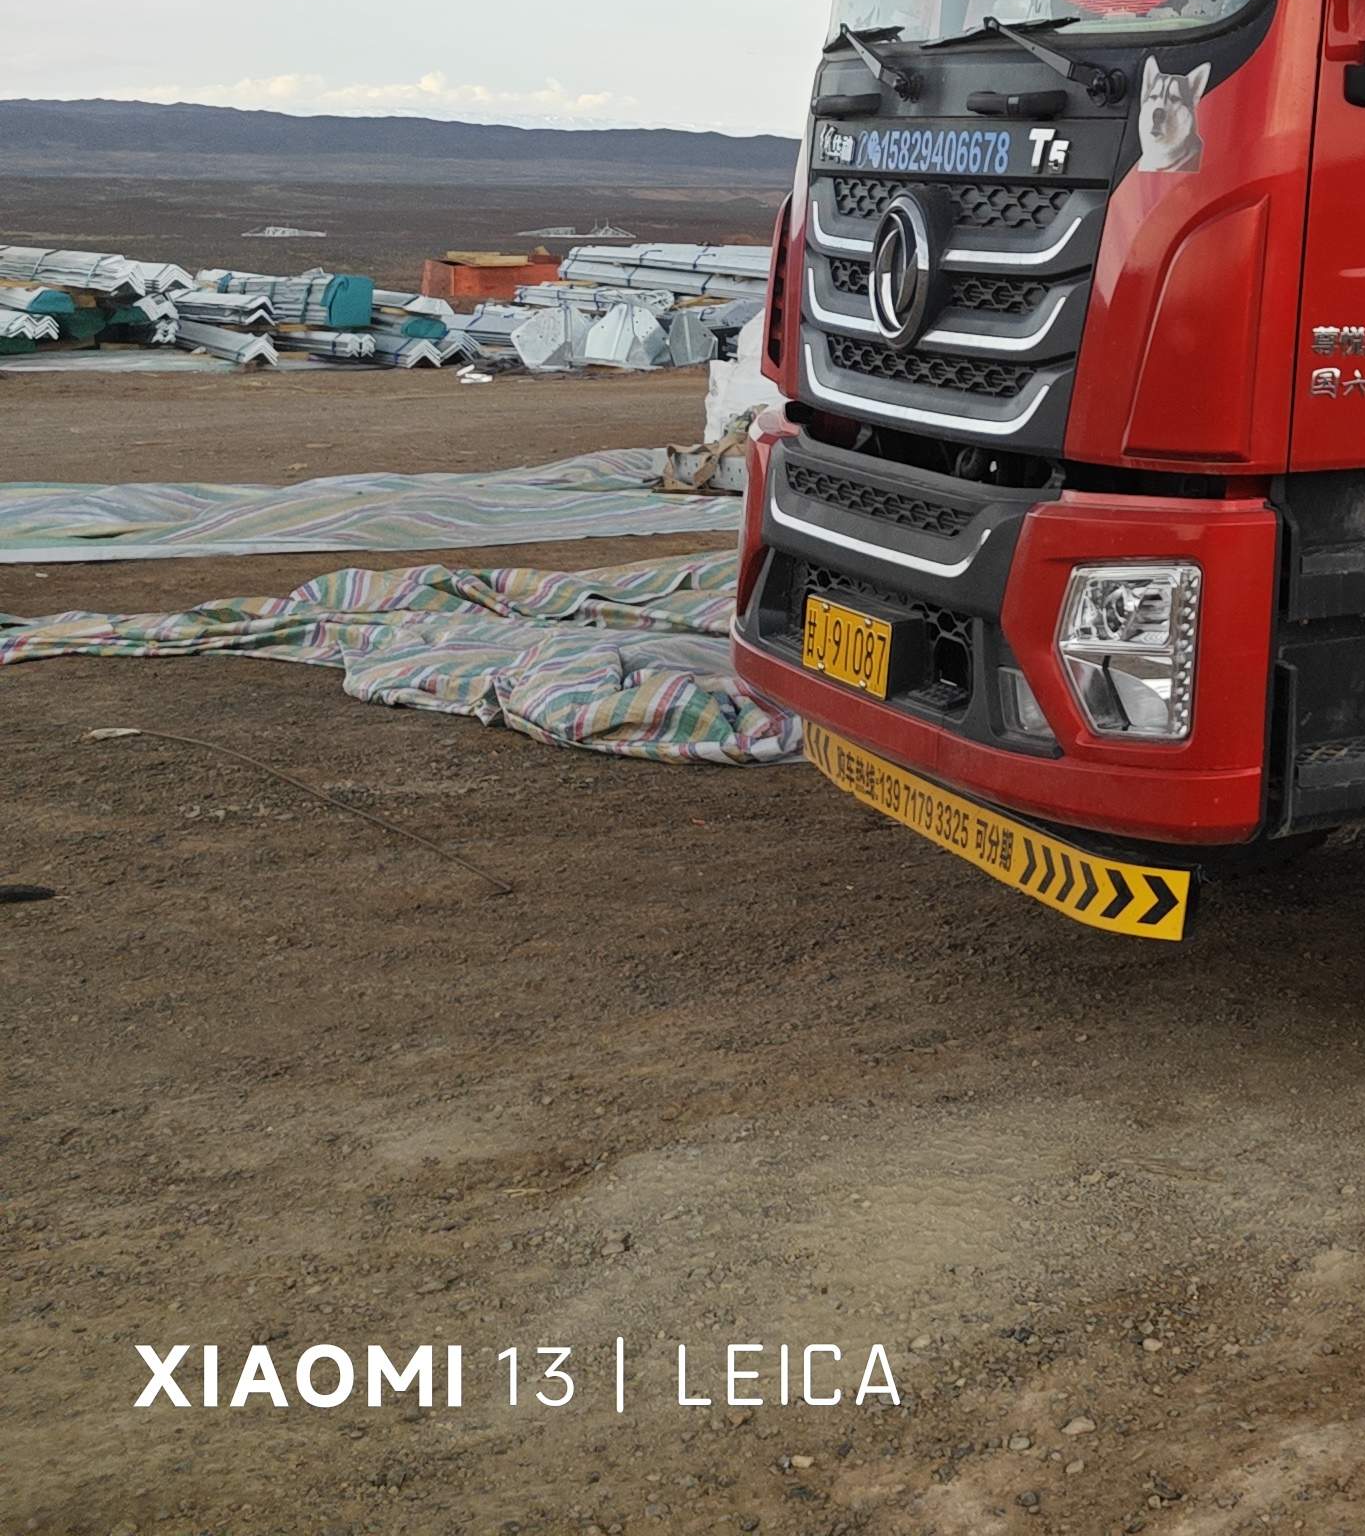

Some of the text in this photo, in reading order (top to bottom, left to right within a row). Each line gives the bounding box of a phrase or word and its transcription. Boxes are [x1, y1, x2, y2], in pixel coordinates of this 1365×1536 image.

[881, 130, 1011, 174] 15829406678
[1028, 127, 1071, 175] T5
[903, 783, 934, 831] 7179
[935, 800, 969, 849] 3325
[975, 817, 1014, 873] 可分期
